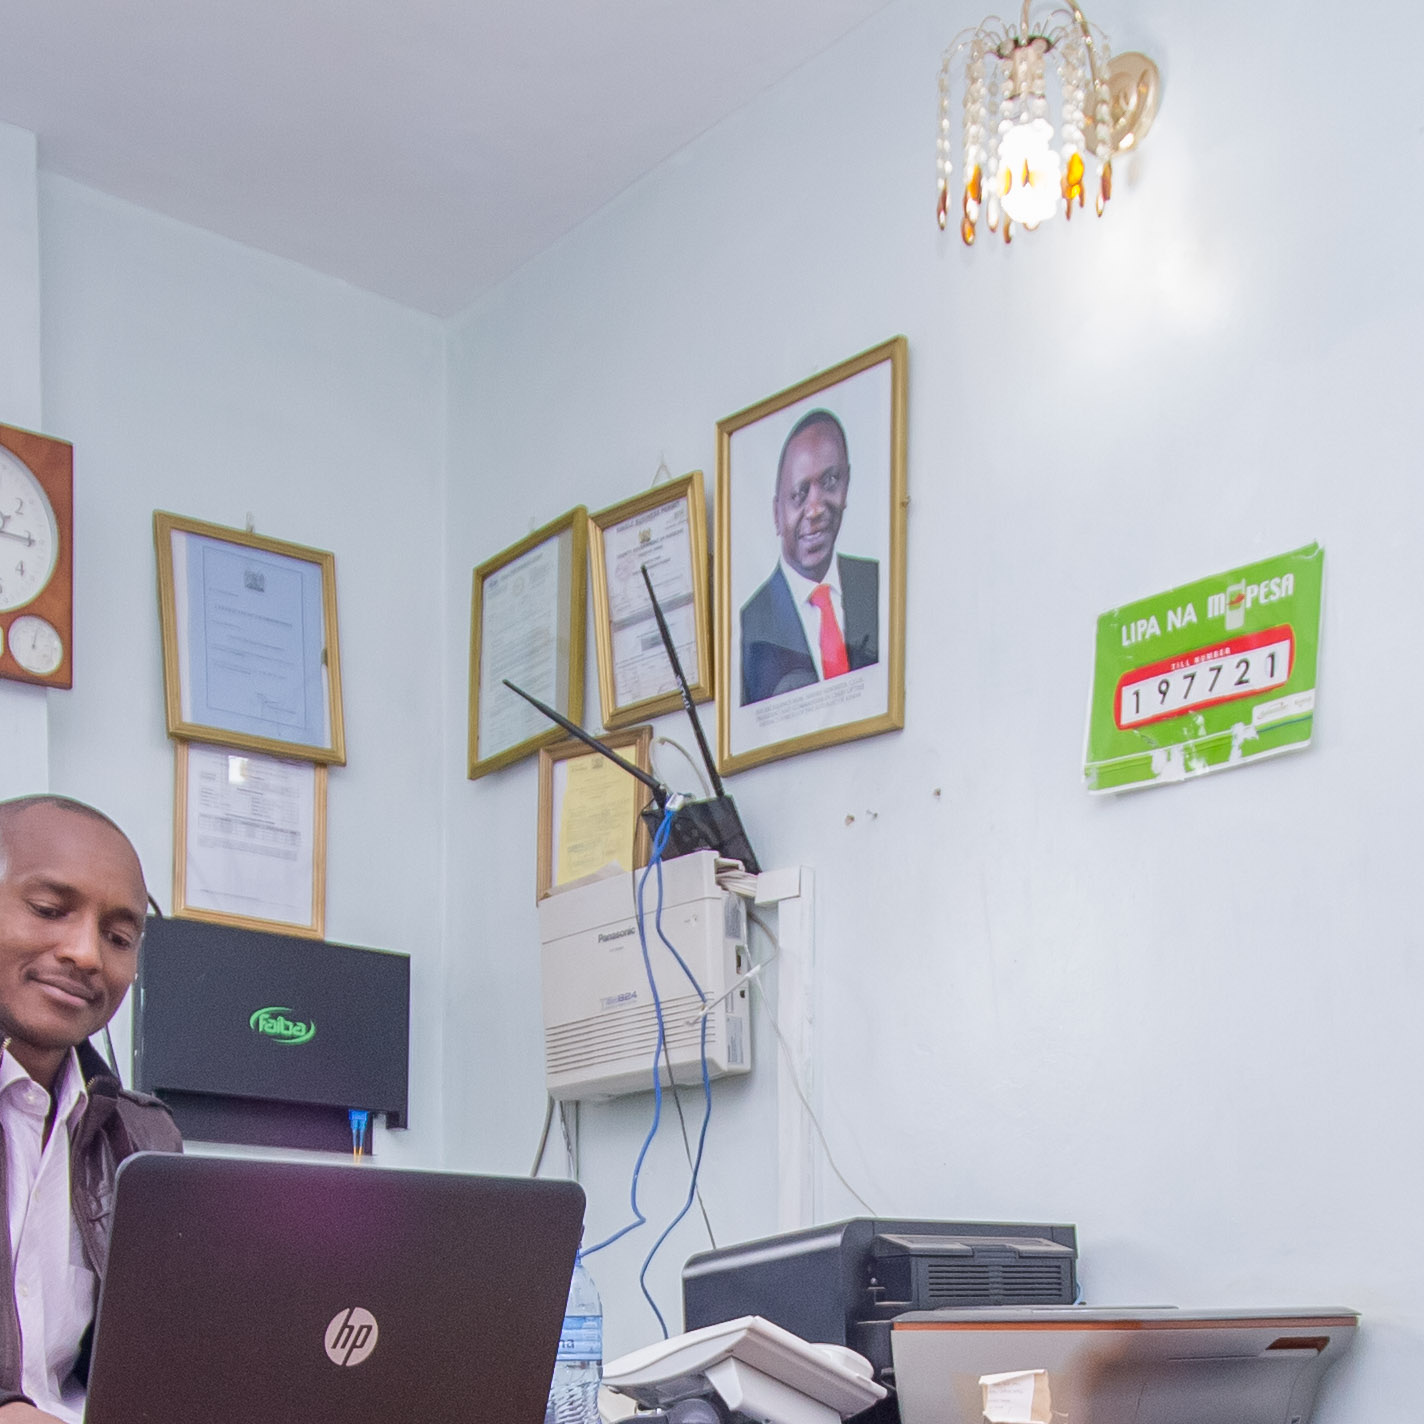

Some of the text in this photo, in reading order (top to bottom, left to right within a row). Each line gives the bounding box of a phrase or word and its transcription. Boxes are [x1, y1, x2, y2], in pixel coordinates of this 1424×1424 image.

[15, 498, 24, 515] 2
[15, 560, 25, 577] 4
[1121, 615, 1161, 647] LIPA
[1166, 602, 1198, 632] NA
[1170, 646, 1231, 671] TILL NUMBER
[598, 927, 636, 943] Panasonic
[258, 1012, 307, 1037] faiba
[330, 1306, 373, 1366] hp
